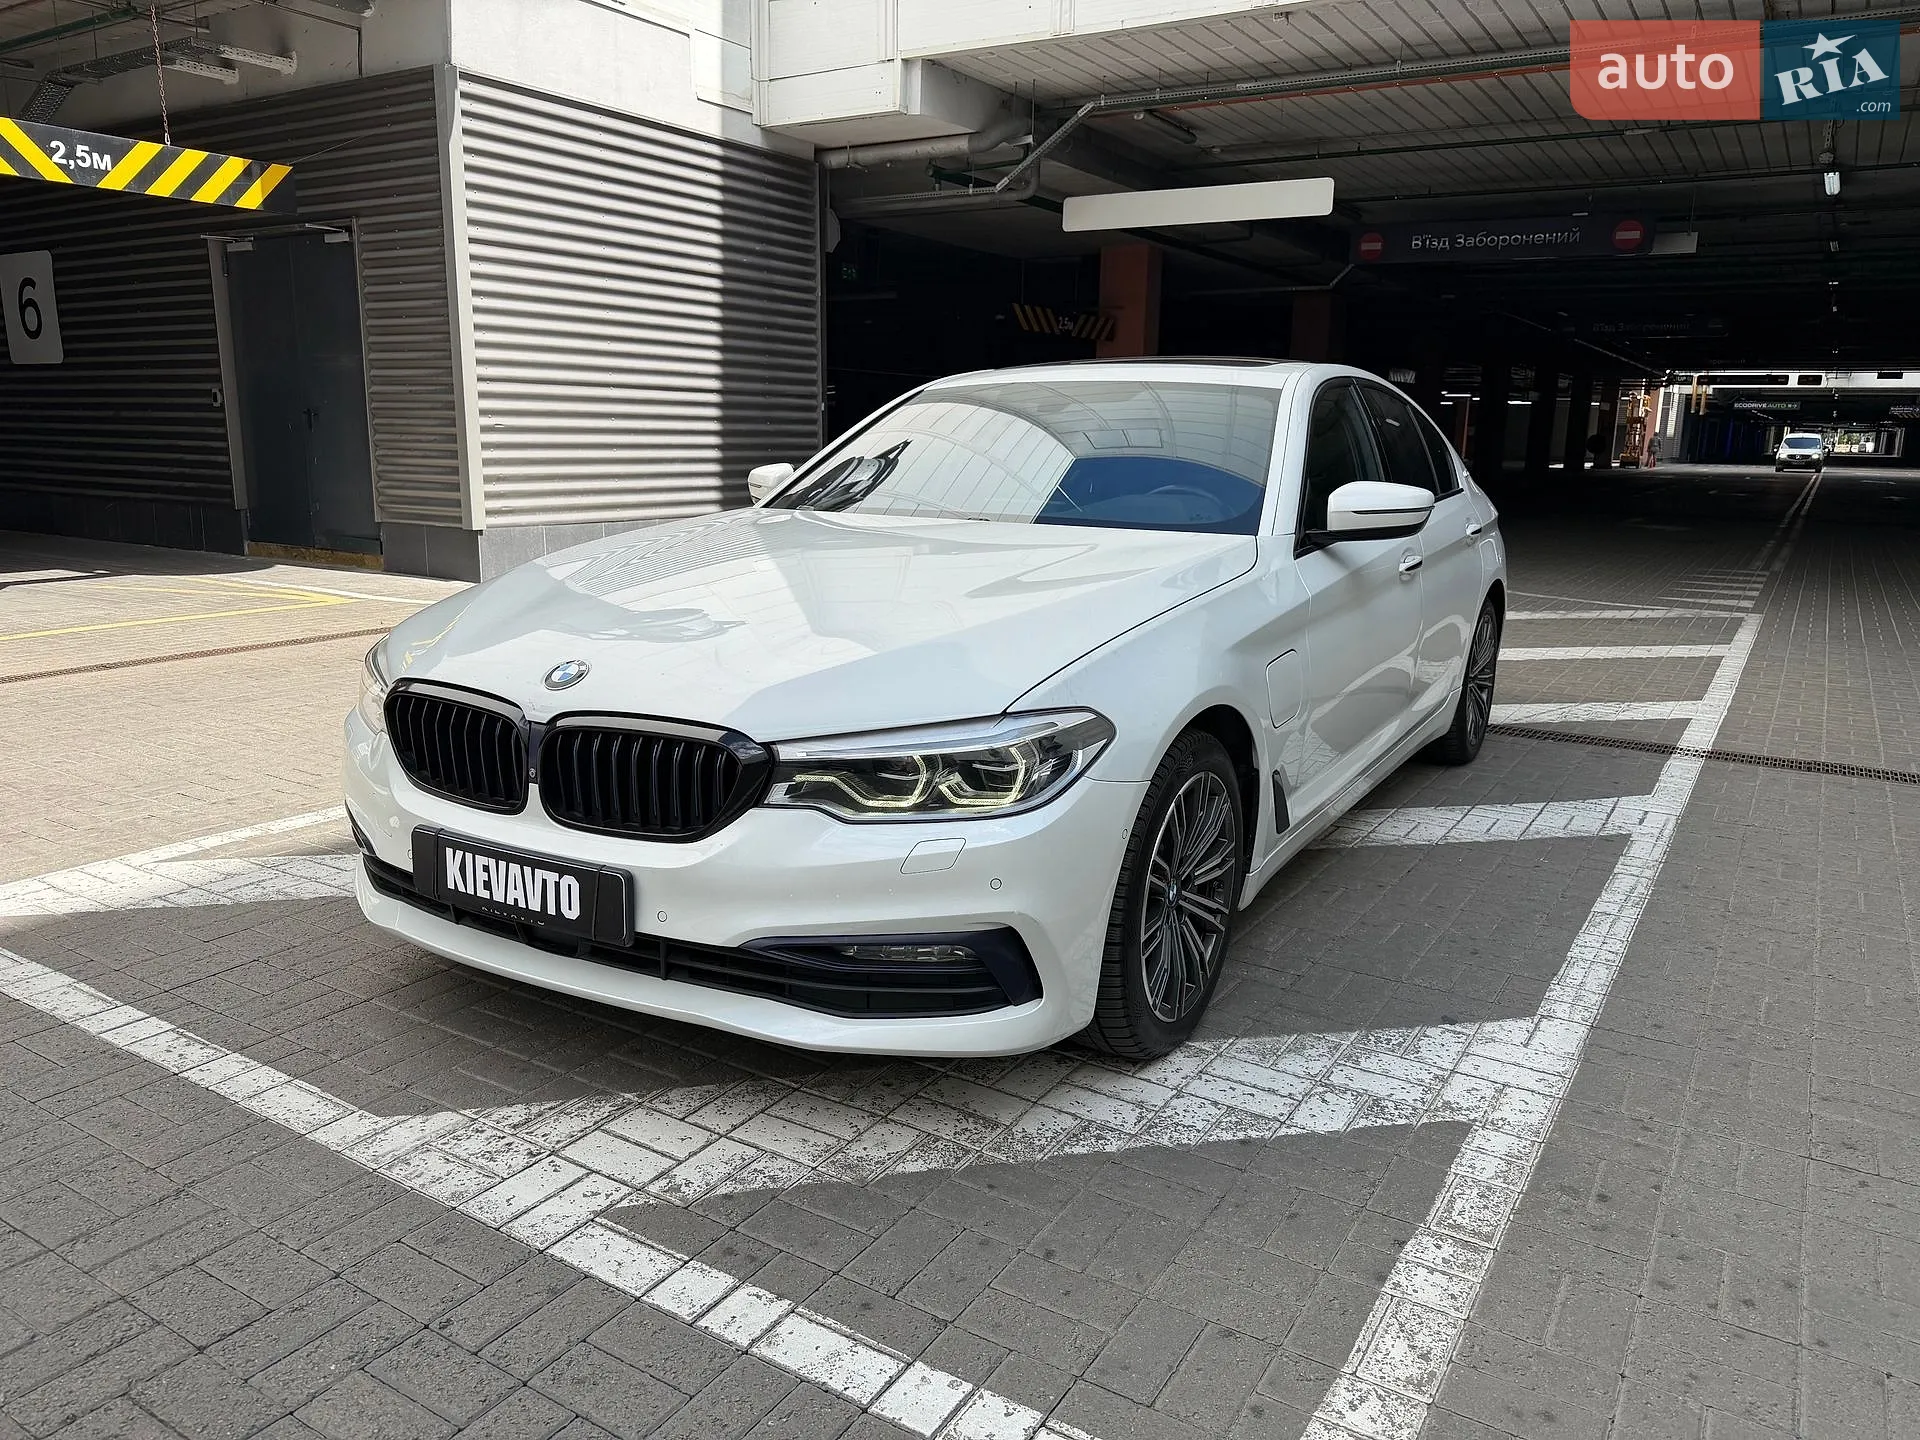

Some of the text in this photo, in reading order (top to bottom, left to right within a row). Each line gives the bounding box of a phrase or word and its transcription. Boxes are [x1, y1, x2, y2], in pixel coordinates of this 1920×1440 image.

[1454, 227, 1581, 250] Заборонений
[18, 277, 42, 340] 6
[445, 847, 580, 921] KIEVAVTO
